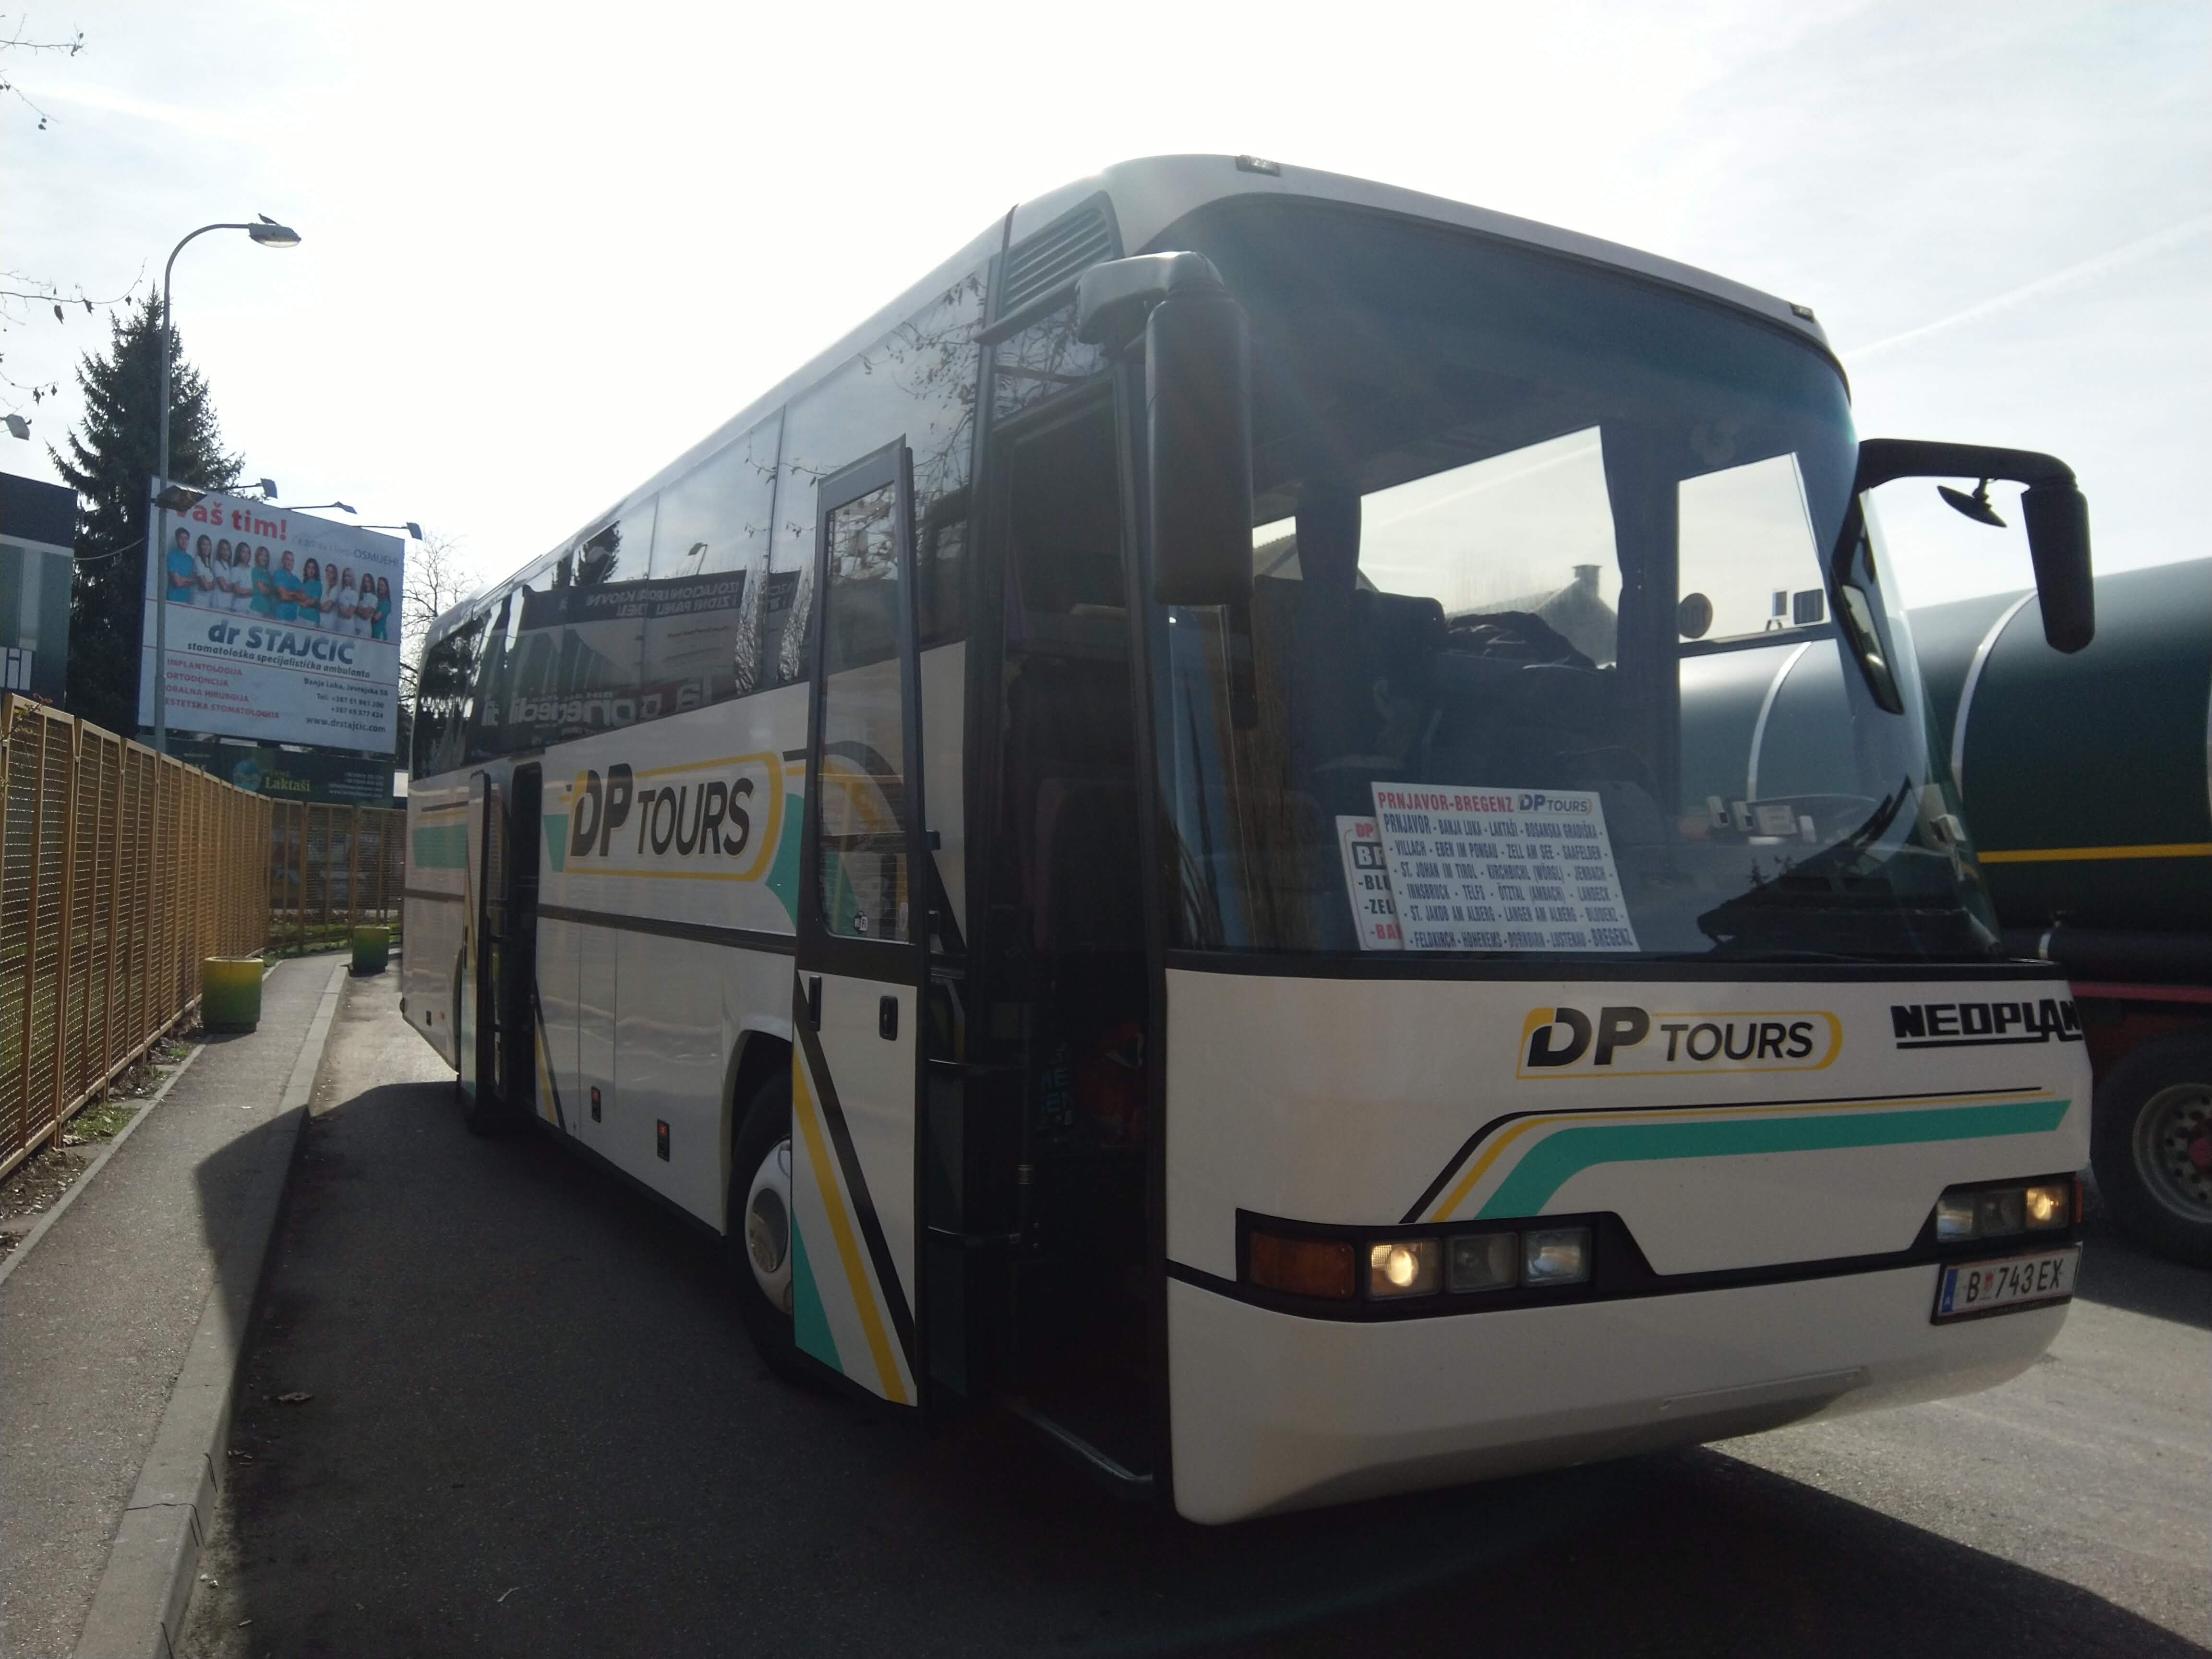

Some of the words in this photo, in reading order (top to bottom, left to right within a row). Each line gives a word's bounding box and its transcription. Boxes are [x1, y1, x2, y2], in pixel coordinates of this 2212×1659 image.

[177, 502, 223, 526] aš
[232, 510, 287, 541] tim!
[208, 619, 240, 645] dr
[168, 659, 242, 676] IMPLANTOLOGIJA
[187, 642, 254, 660] stomatološka
[257, 654, 321, 672] specijalistička
[324, 665, 370, 678] ambulanta
[166, 673, 228, 687] ORTODONCIJA
[304, 677, 324, 687] Banja
[166, 685, 202, 695] ORALNA
[204, 690, 249, 703] HIRURGIJA
[165, 698, 208, 710] ESTETSKA
[211, 704, 279, 719] STOMATOLOGIJA
[265, 777, 310, 792] Laktaši
[571, 763, 633, 856] DP
[637, 777, 754, 856] TOURS
[1378, 792, 1515, 813] PRNJAVOR-BREGENZ
[1520, 794, 1546, 811] DP
[1547, 800, 1587, 812] TOURS
[1355, 822, 1374, 838] DP
[1383, 813, 1432, 834] PRNJAVOR
[1438, 819, 1463, 835] BANJA
[1463, 820, 1483, 836] LUKA
[1395, 840, 1427, 857] VILLACH
[1435, 841, 1455, 858] EBEN
[1469, 842, 1498, 858] PONGAU
[1506, 843, 1524, 859] ZELL
[1527, 843, 1539, 860] AM
[1540, 844, 1554, 860] SEE
[1400, 861, 1413, 878] ST.
[1455, 863, 1478, 879] TIROL
[1407, 883, 1451, 900] INNSBRUCK
[1462, 884, 1486, 901] TELFS
[1577, 886, 1611, 902] LANDECK
[1364, 899, 1397, 914] -ZEL
[1410, 904, 1423, 922] ST.
[1425, 905, 1450, 922] JAKOB
[1451, 905, 1465, 922] AM
[1414, 931, 1456, 948] FELDKIRCH
[1590, 927, 1634, 947] BREGENZ
[1890, 999, 2083, 1043] NEOPLAN
[1527, 1006, 1650, 1067] DP
[1660, 1022, 1813, 1062] TOURS
